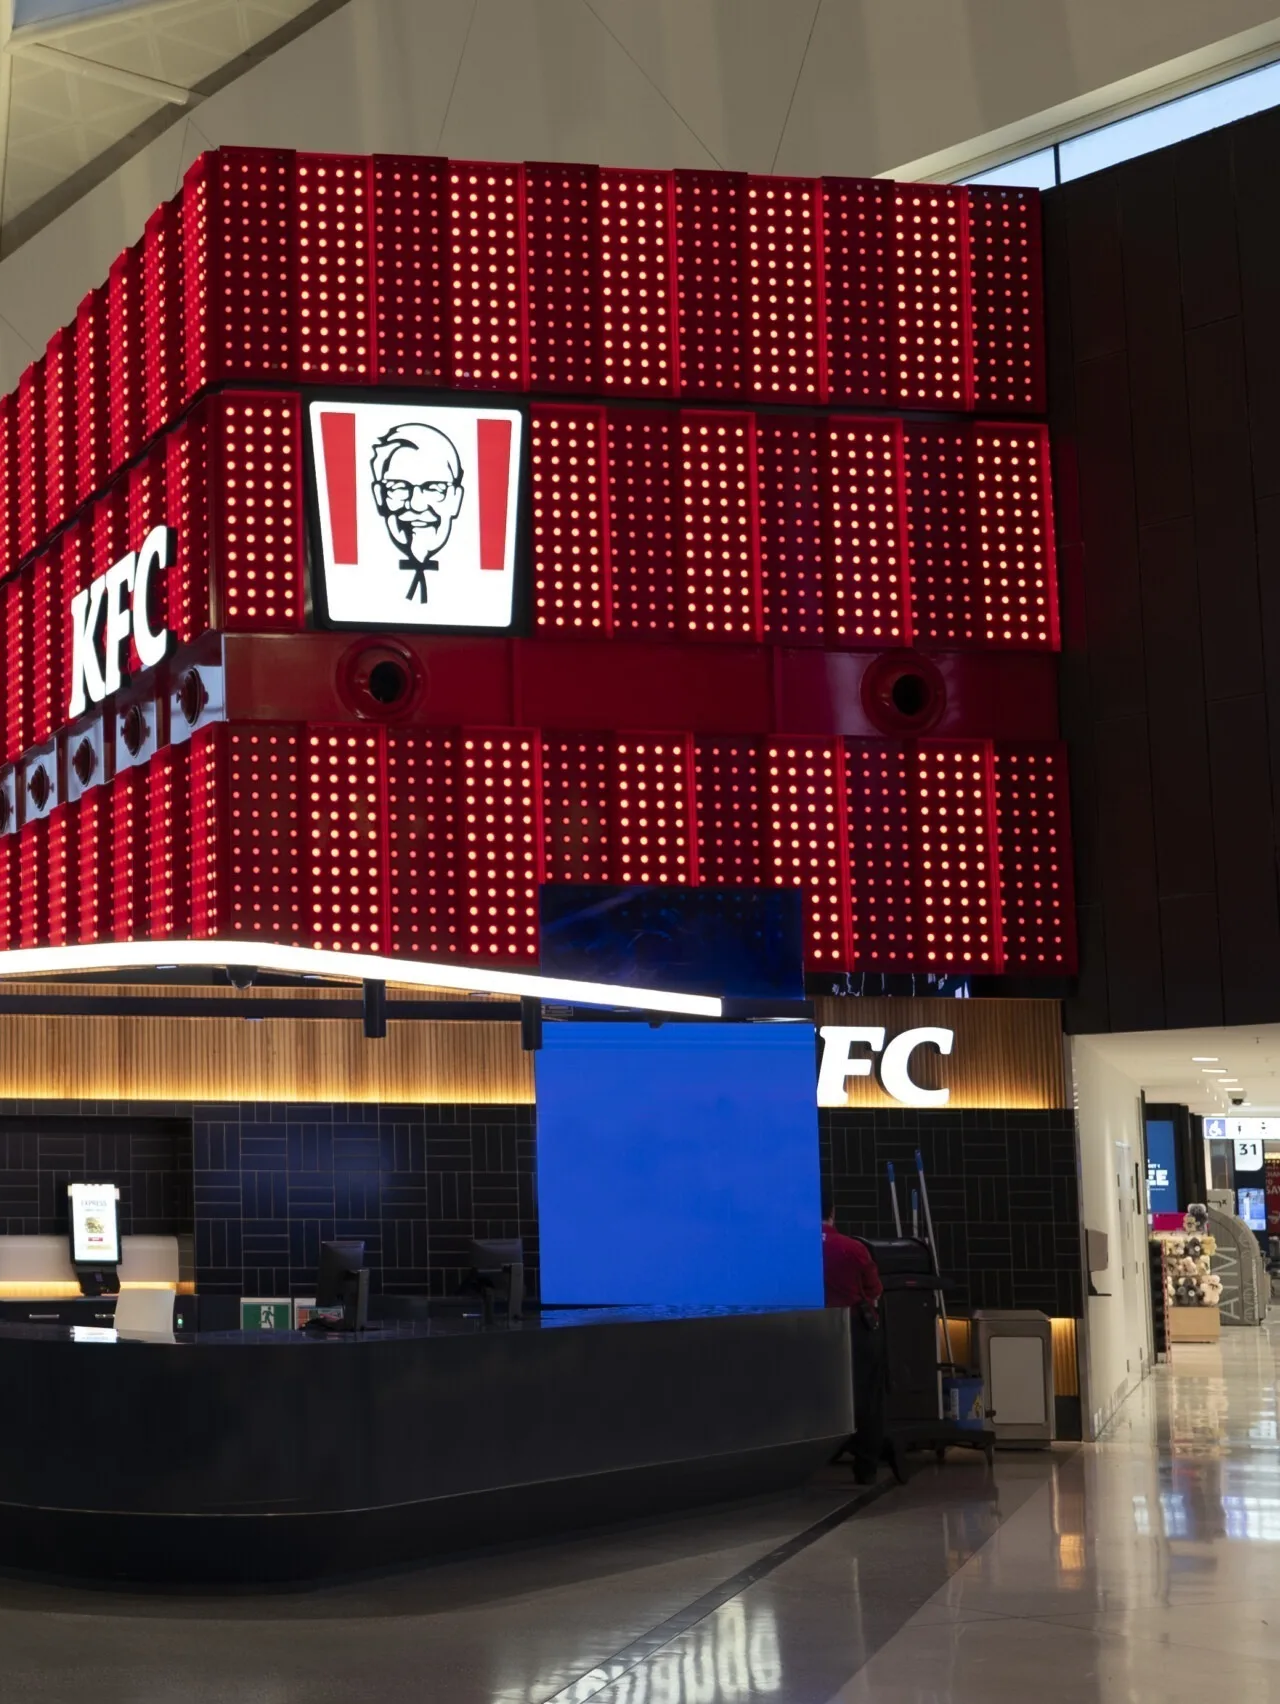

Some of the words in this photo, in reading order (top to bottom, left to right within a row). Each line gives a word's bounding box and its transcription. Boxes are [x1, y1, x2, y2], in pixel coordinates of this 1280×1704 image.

[69, 525, 167, 719] KFC
[816, 1026, 954, 1108] FC
[1239, 1143, 1257, 1155] 31
